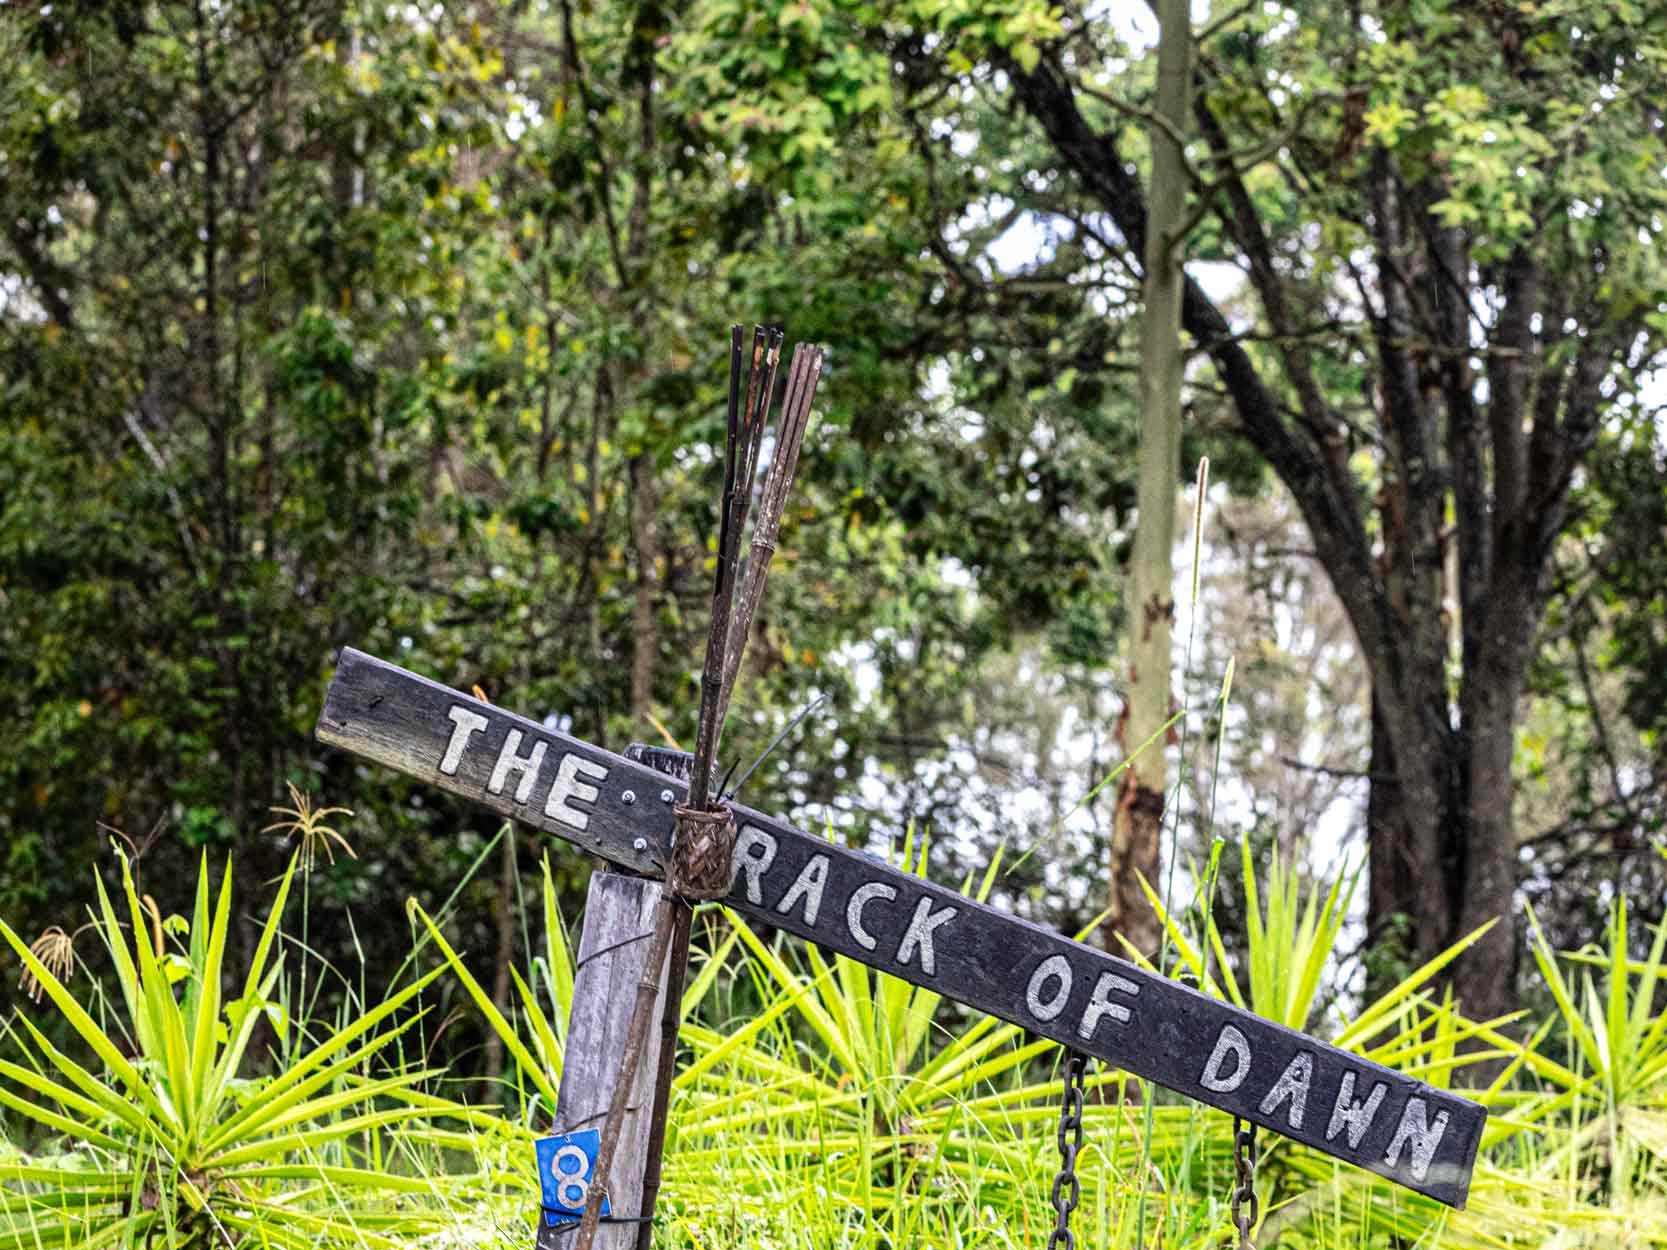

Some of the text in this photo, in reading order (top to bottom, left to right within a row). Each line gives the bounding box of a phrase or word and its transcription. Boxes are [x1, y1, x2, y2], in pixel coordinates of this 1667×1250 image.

[439, 705, 1450, 1183] THE RACK OF DAWN
[551, 1145, 589, 1209] 8
